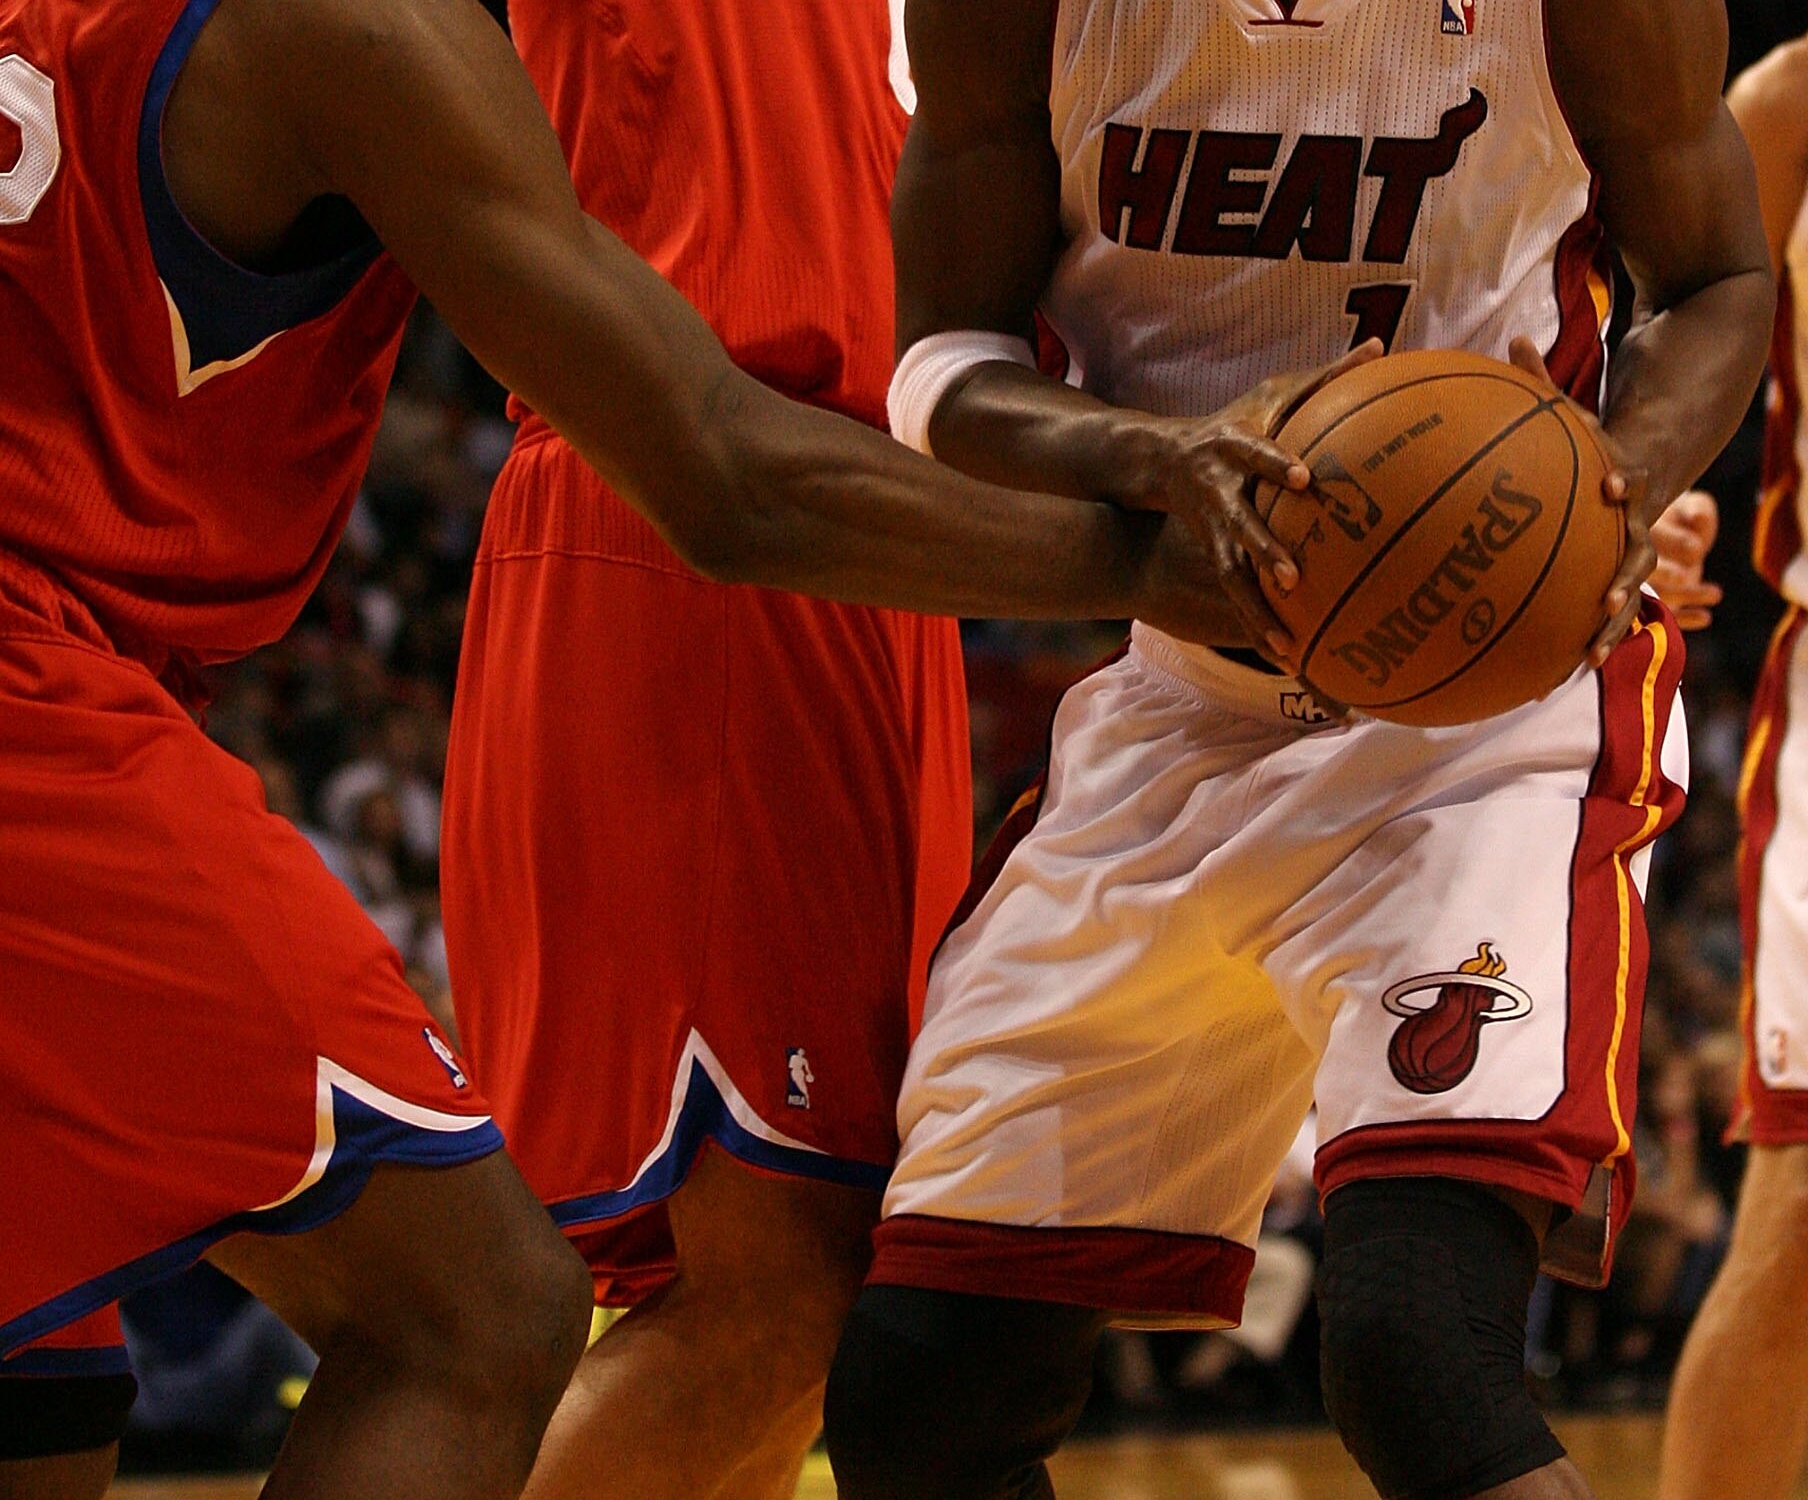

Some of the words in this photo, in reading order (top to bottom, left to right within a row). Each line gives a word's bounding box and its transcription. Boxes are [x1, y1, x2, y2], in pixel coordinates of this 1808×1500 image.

[1442, 20, 1463, 32] NBA
[1098, 87, 1489, 265] HEAT
[1344, 283, 1413, 358] 1
[1329, 469, 1542, 687] SPALDING
